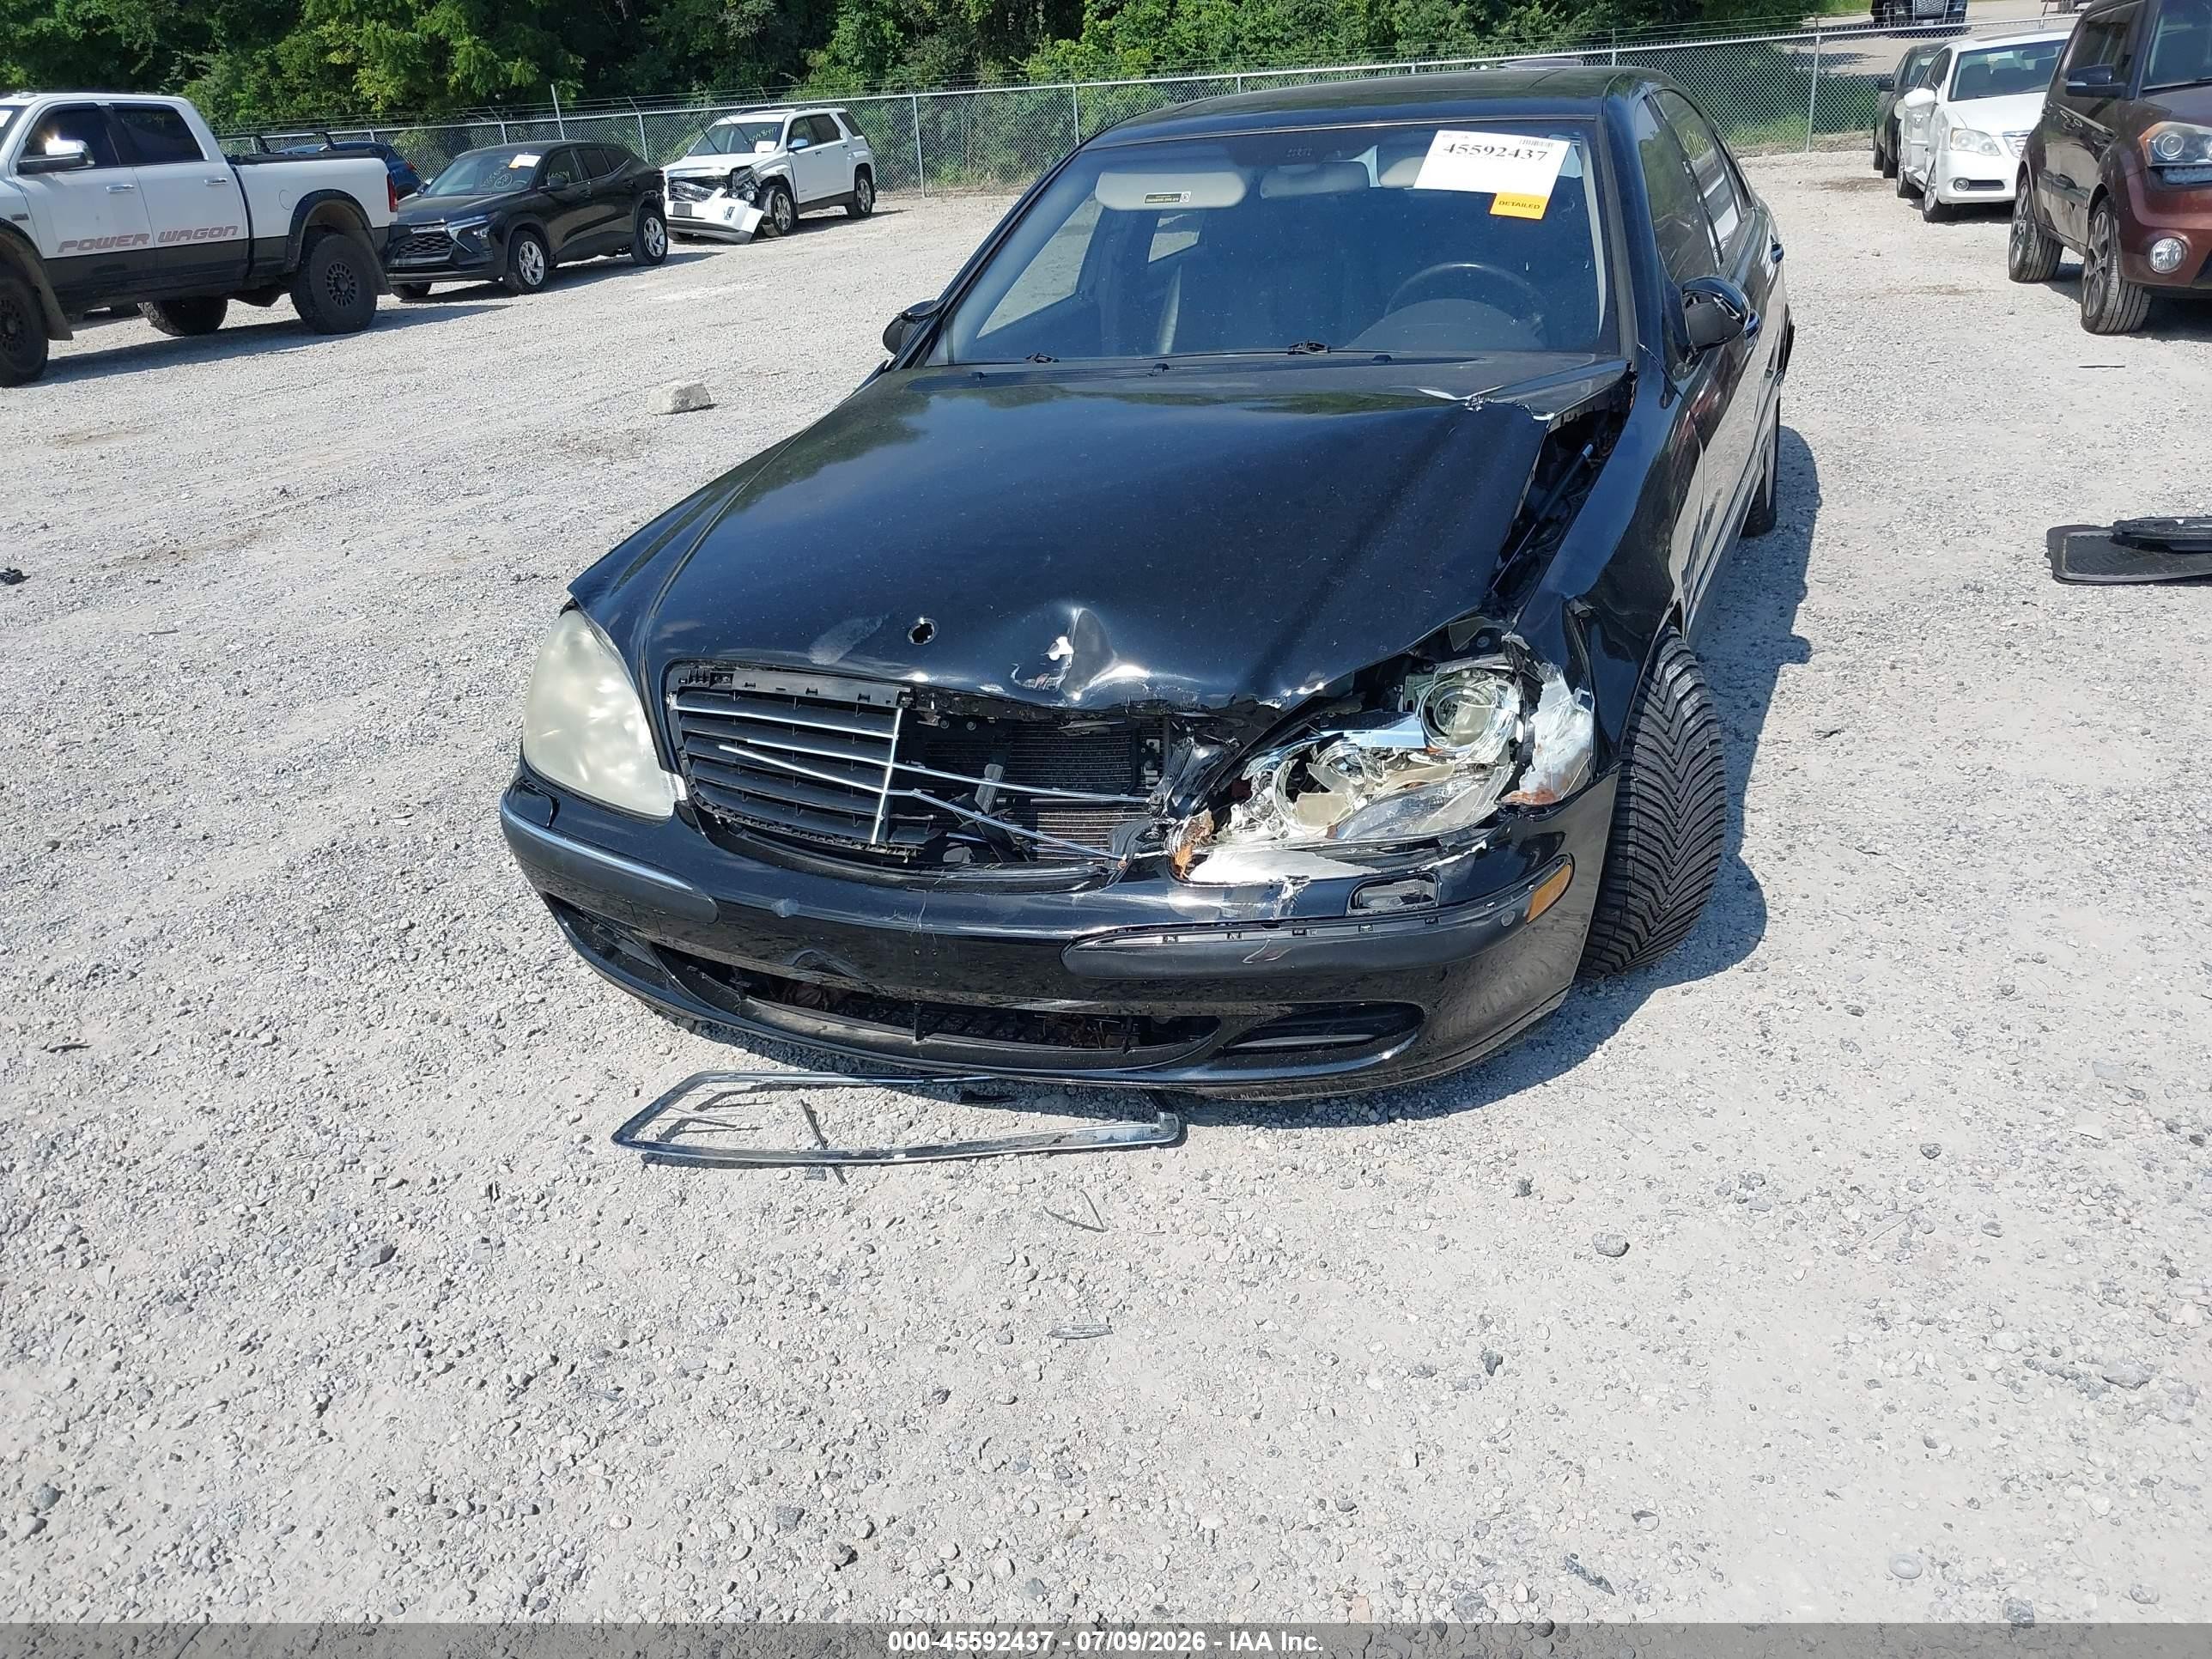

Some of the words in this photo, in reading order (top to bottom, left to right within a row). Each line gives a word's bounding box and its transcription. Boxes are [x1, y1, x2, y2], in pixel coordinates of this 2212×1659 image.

[1443, 143, 1548, 161] 45592437
[1498, 199, 1540, 210] DETAILED
[57, 233, 150, 253] POWER
[157, 225, 239, 243] WAGON
